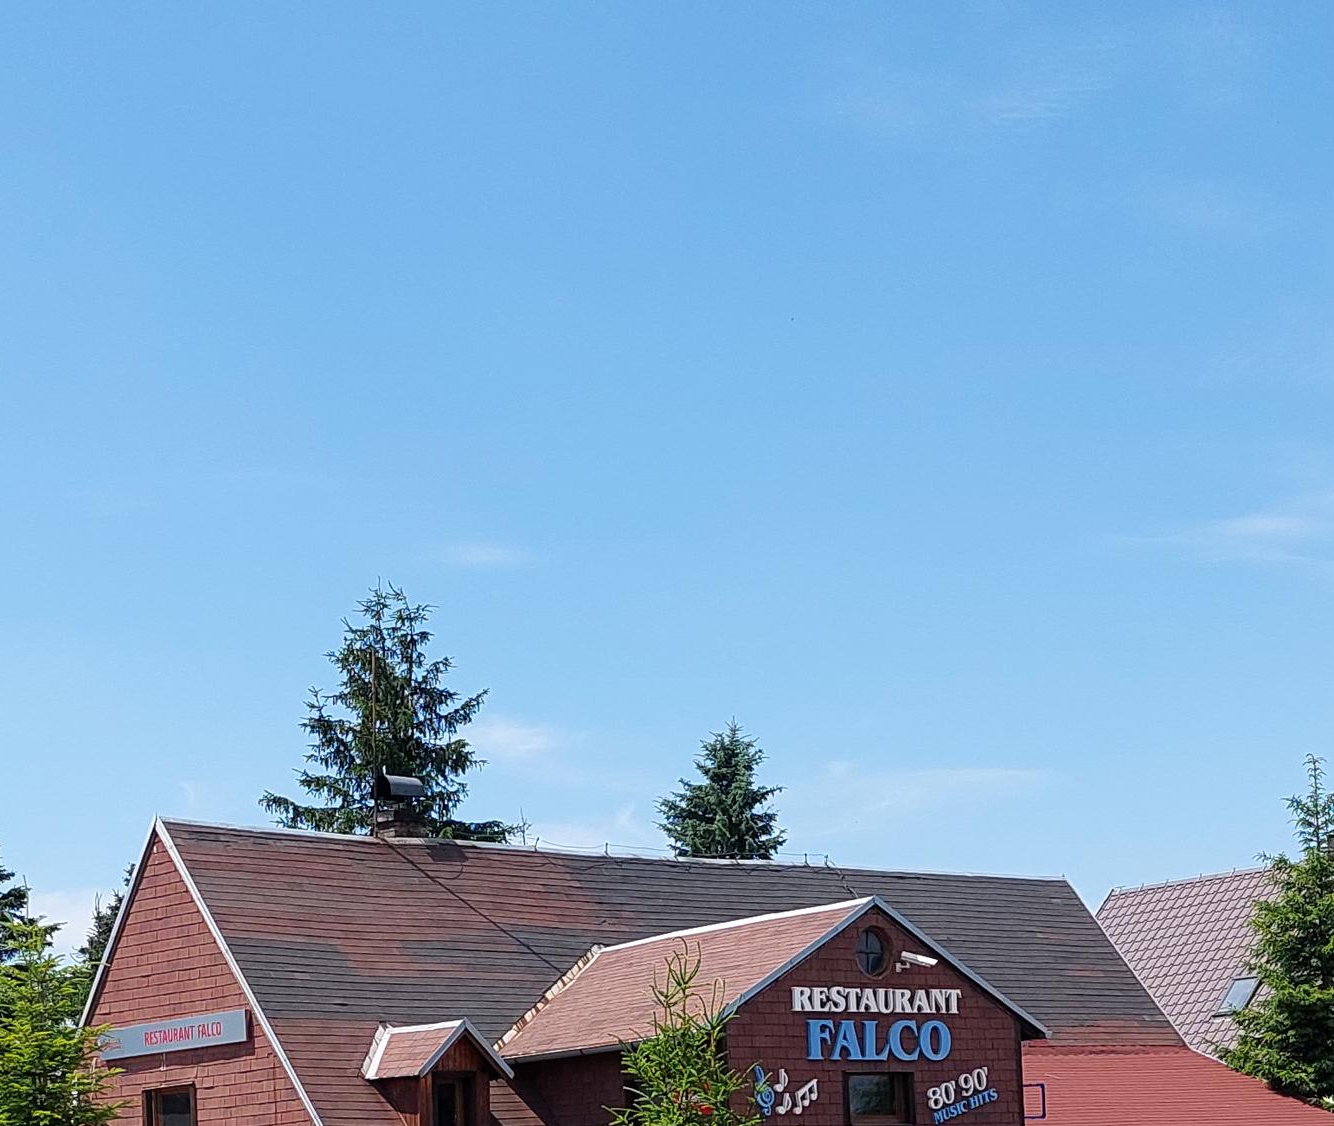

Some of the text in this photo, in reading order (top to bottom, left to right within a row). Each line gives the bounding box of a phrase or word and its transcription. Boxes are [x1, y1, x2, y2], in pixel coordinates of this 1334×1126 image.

[792, 987, 961, 1014] RESTAURANT
[144, 1022, 222, 1046] RESTAURANT FALCO
[807, 1019, 952, 1061] FALCO
[933, 1088, 998, 1125] MUSIC HITS
